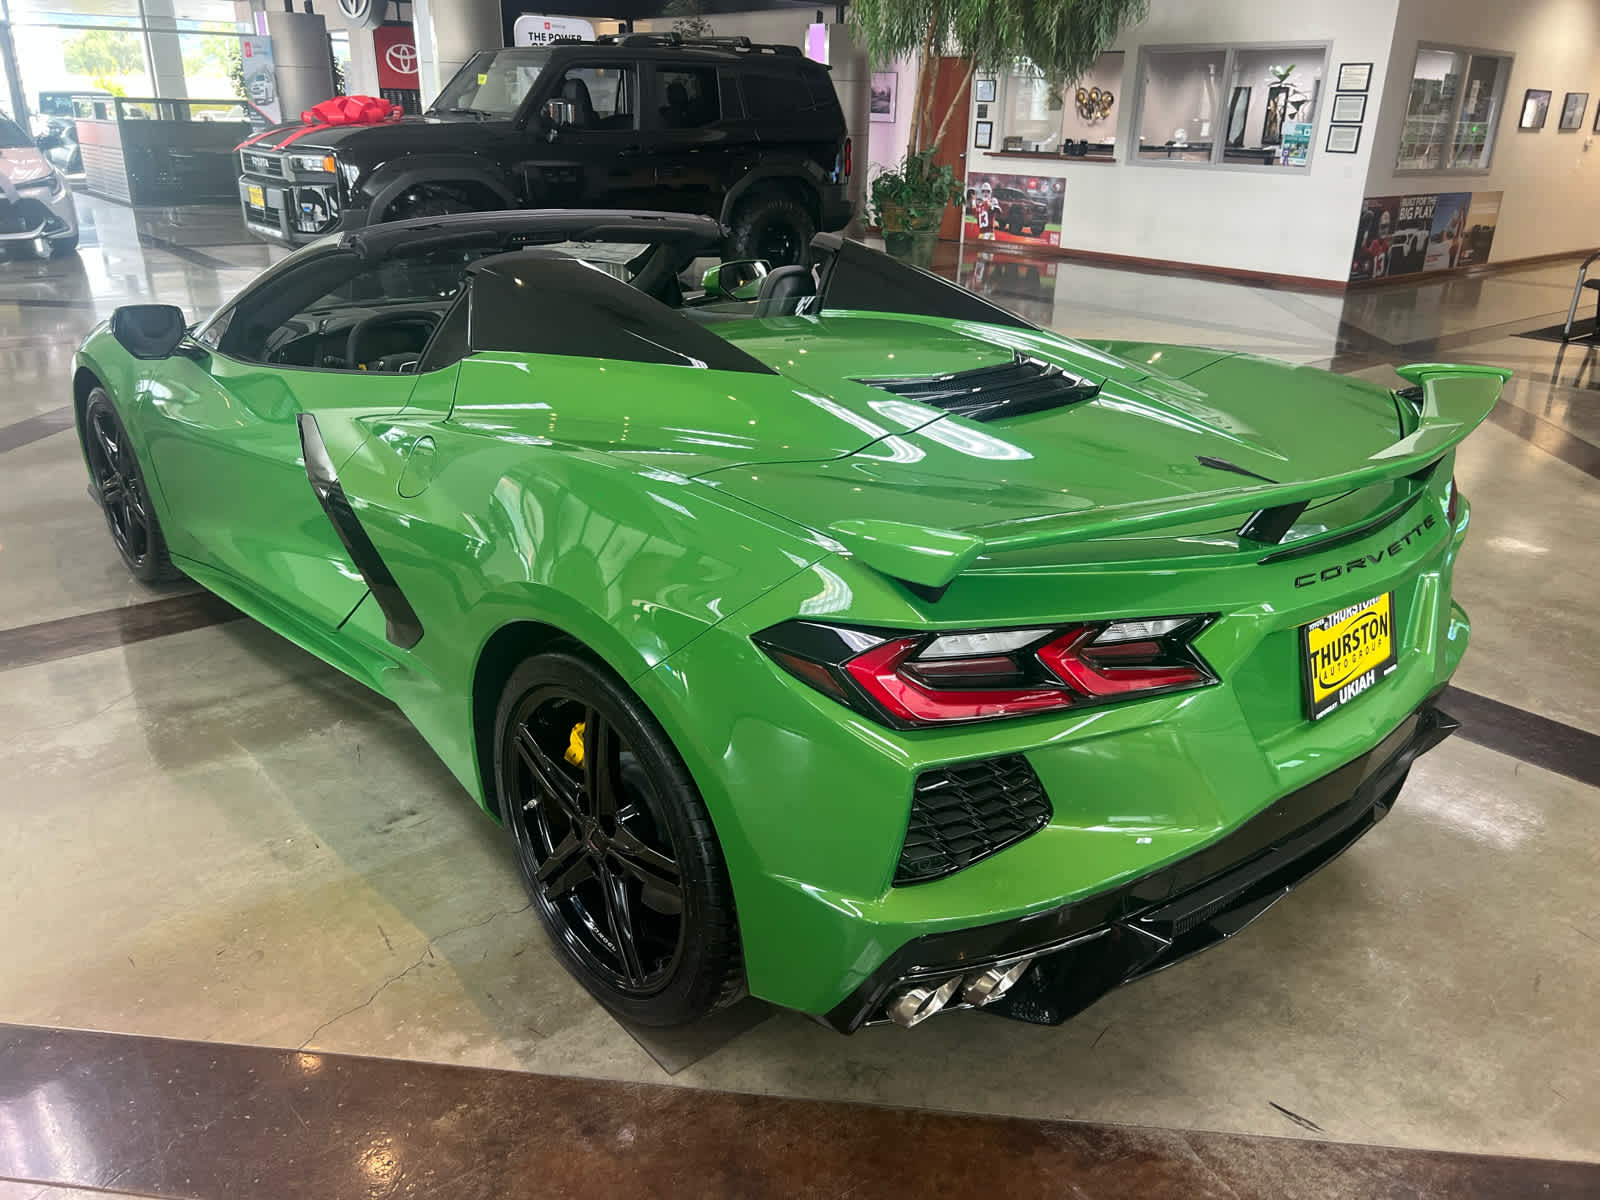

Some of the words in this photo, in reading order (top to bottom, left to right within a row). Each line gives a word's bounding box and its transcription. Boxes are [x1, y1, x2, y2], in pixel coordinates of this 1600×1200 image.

[528, 32, 546, 41] THE
[1400, 207, 1414, 220] BIG
[1295, 514, 1435, 588] CORVETTE
[1310, 611, 1388, 679] THURSTON
[1339, 669, 1375, 704] UKIAH
